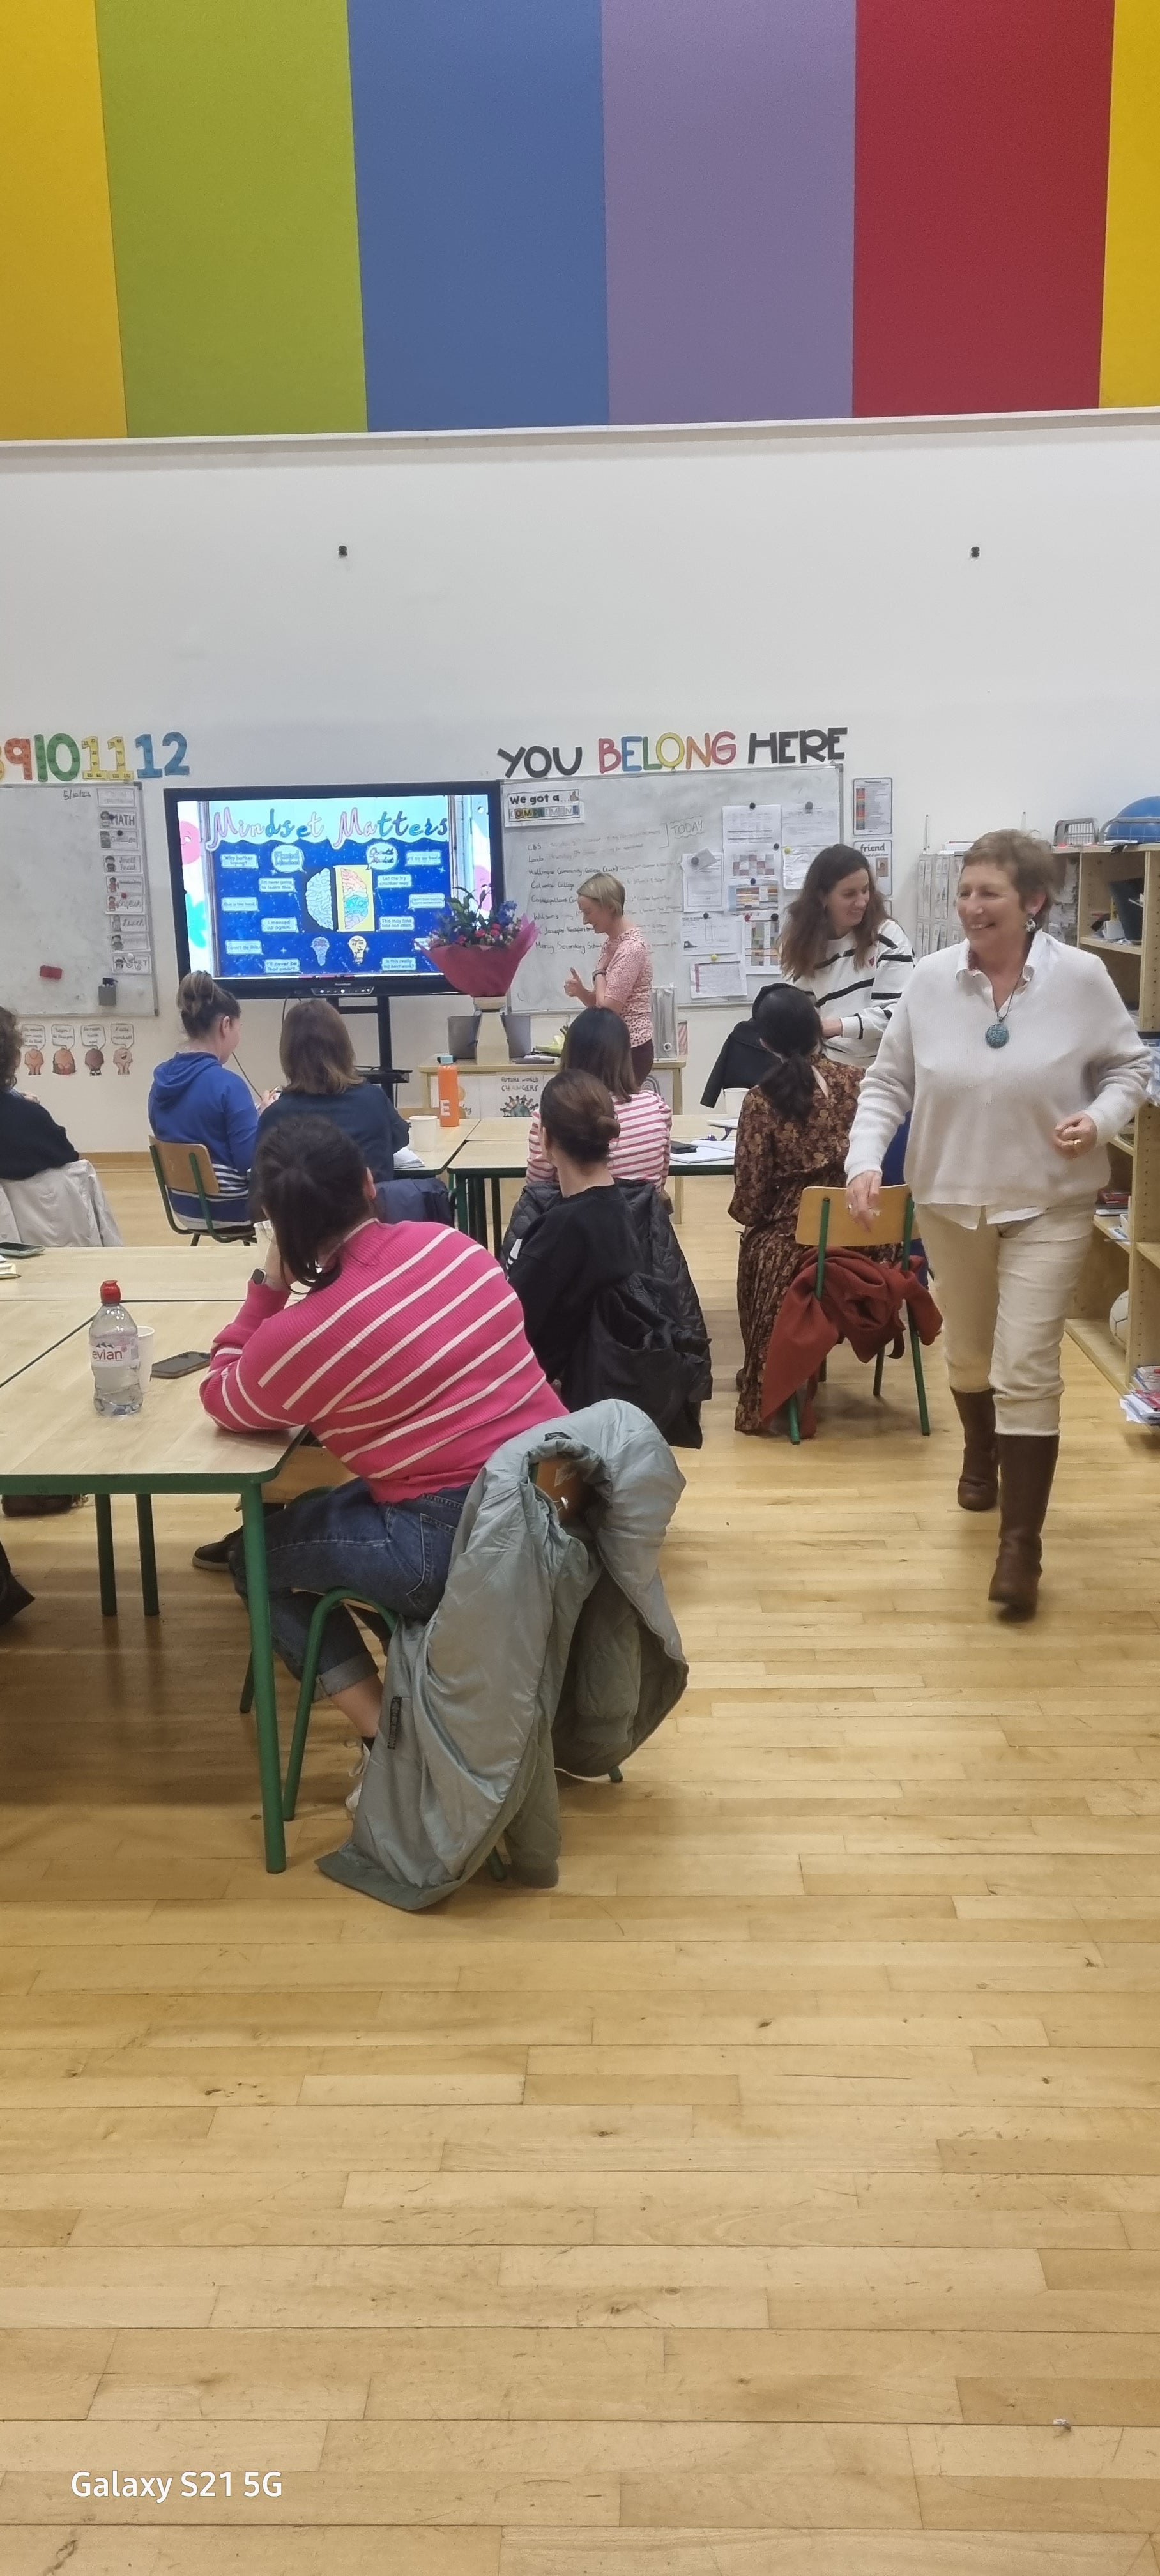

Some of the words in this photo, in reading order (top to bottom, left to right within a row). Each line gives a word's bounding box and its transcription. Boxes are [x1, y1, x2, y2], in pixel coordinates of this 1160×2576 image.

[34, 733, 80, 782] 10
[82, 735, 134, 780] 11
[135, 732, 190, 778] 12
[497, 746, 582, 779] YOU
[598, 730, 737, 774] BELONG
[748, 726, 848, 763] HERE
[510, 795, 526, 804] We
[530, 794, 549, 805] got
[208, 807, 324, 848] Mindset
[333, 807, 448, 847] Matters
[671, 820, 703, 834] TODAY
[860, 843, 885, 854] friend
[92, 1349, 123, 1360] evian
